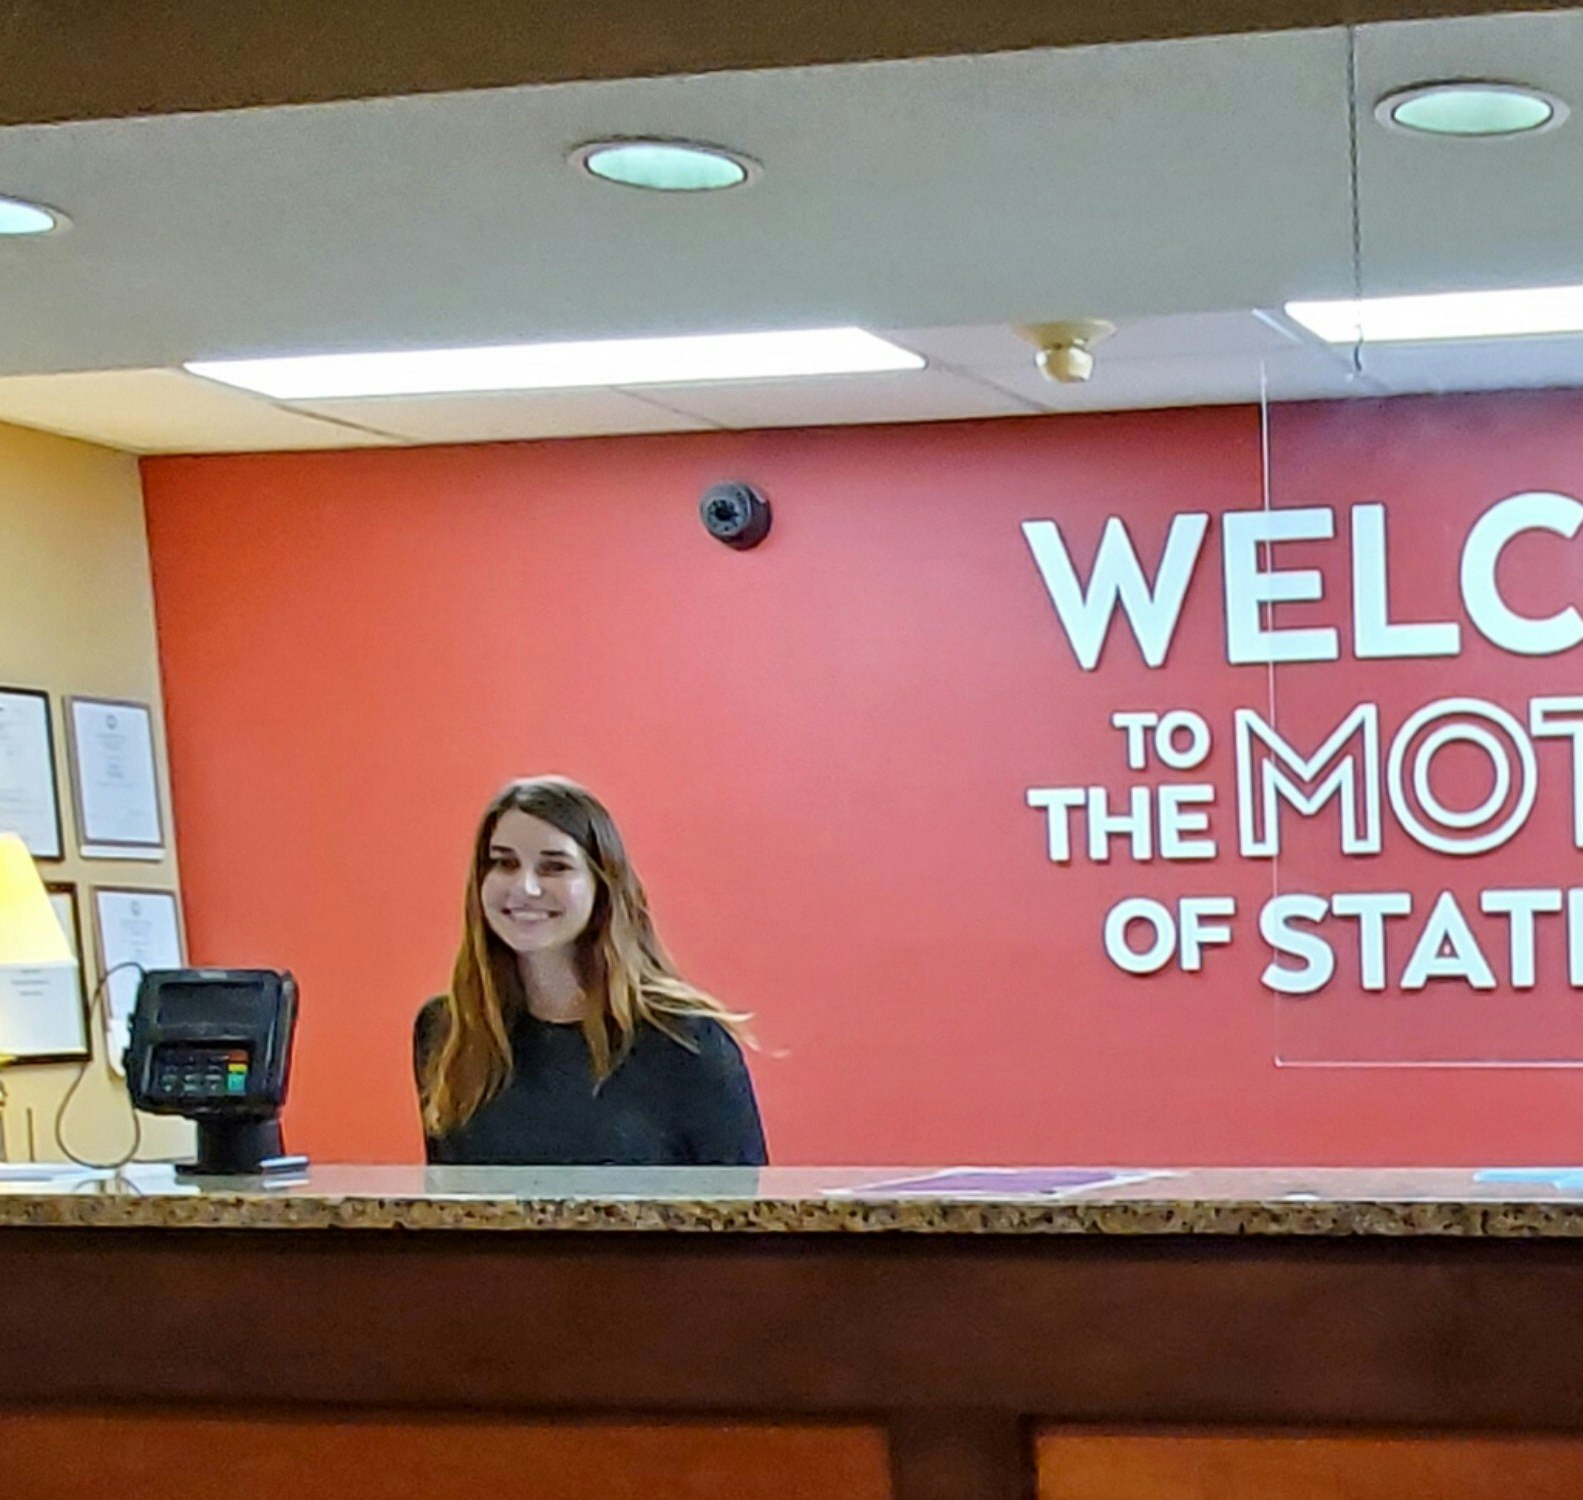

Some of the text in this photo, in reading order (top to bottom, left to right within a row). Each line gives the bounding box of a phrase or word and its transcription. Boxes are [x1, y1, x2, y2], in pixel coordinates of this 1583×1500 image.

[1113, 710, 1210, 770] TO
[1027, 785, 1217, 862] THE
[1103, 896, 1236, 976] OF
